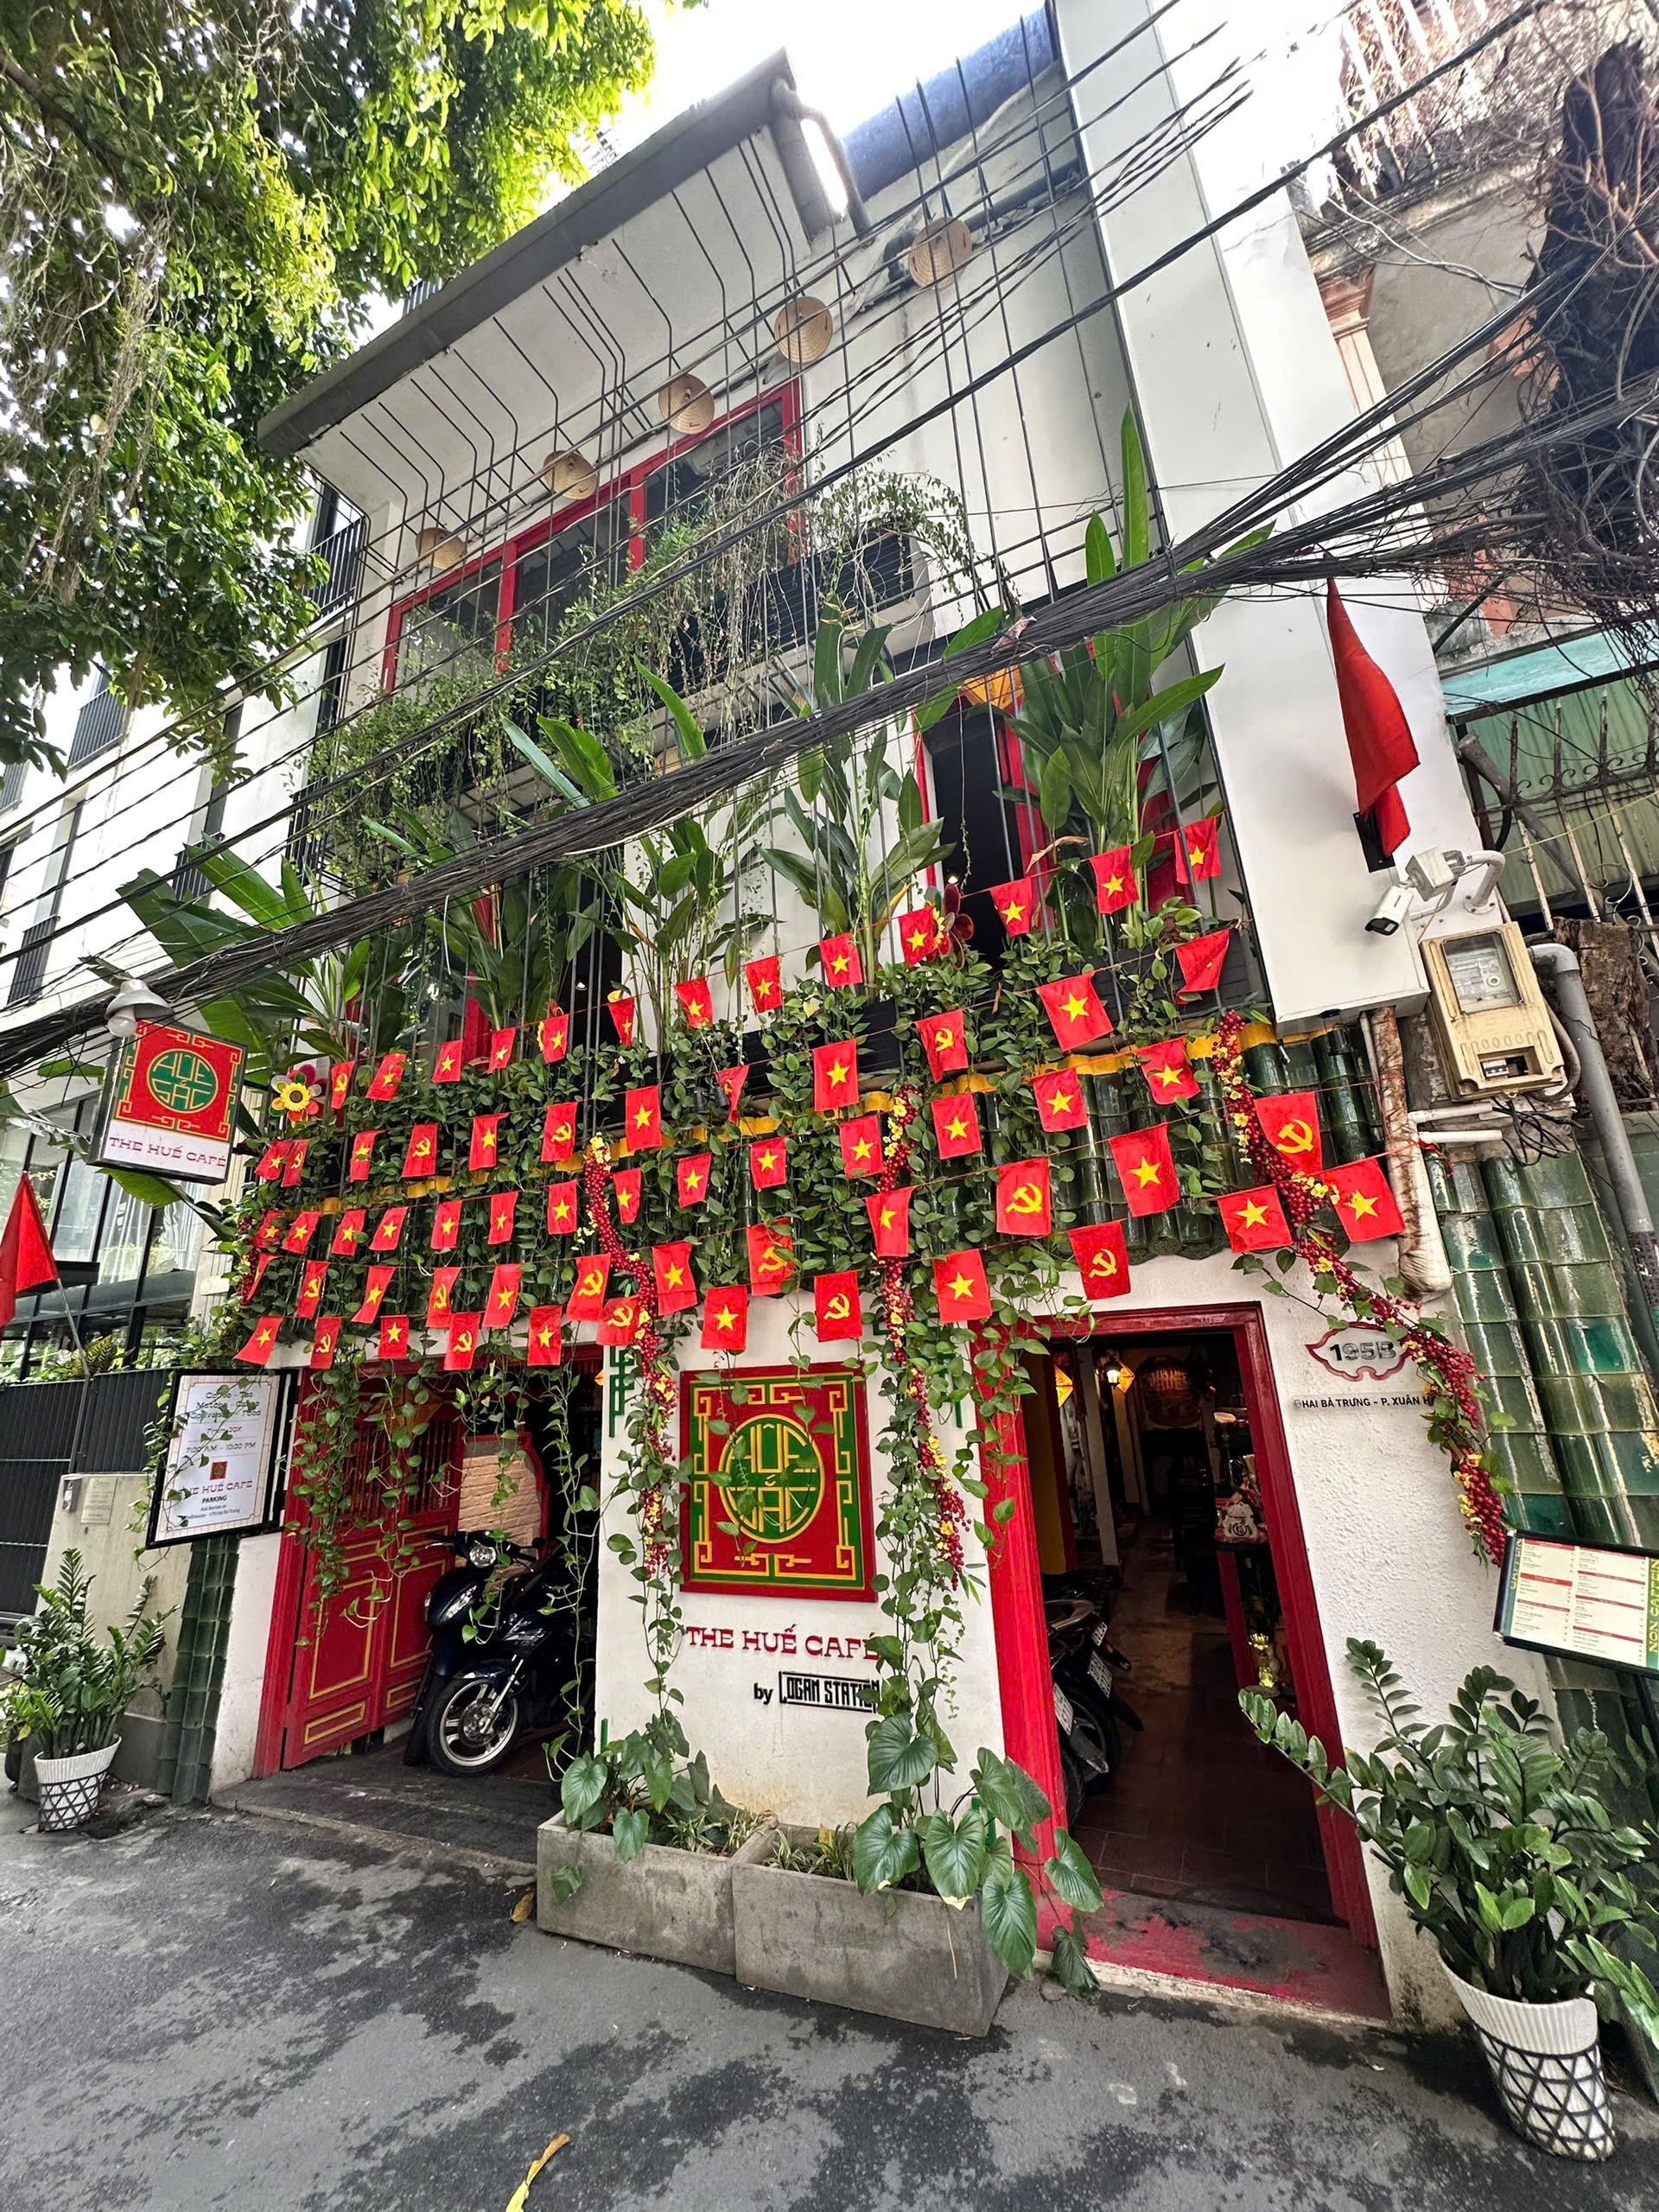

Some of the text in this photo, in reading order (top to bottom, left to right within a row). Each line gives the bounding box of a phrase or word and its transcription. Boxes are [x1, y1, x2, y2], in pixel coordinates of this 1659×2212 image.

[110, 1136, 226, 1167] THE HUẾ CAFÉ
[1329, 1341, 1397, 1362] 195B
[1302, 1399, 1318, 1408] HAI
[1321, 1397, 1334, 1408] BÀ
[1381, 1397, 1390, 1407] P.
[1392, 1394, 1420, 1406] XUÂN
[201, 1495, 227, 1503] PARKING
[685, 1626, 734, 1649] THE
[741, 1624, 798, 1655] HUẾ
[1649, 1621, 1658, 1652] NON
[753, 1682, 773, 1706] by
[779, 1670, 820, 1704] LOGAN
